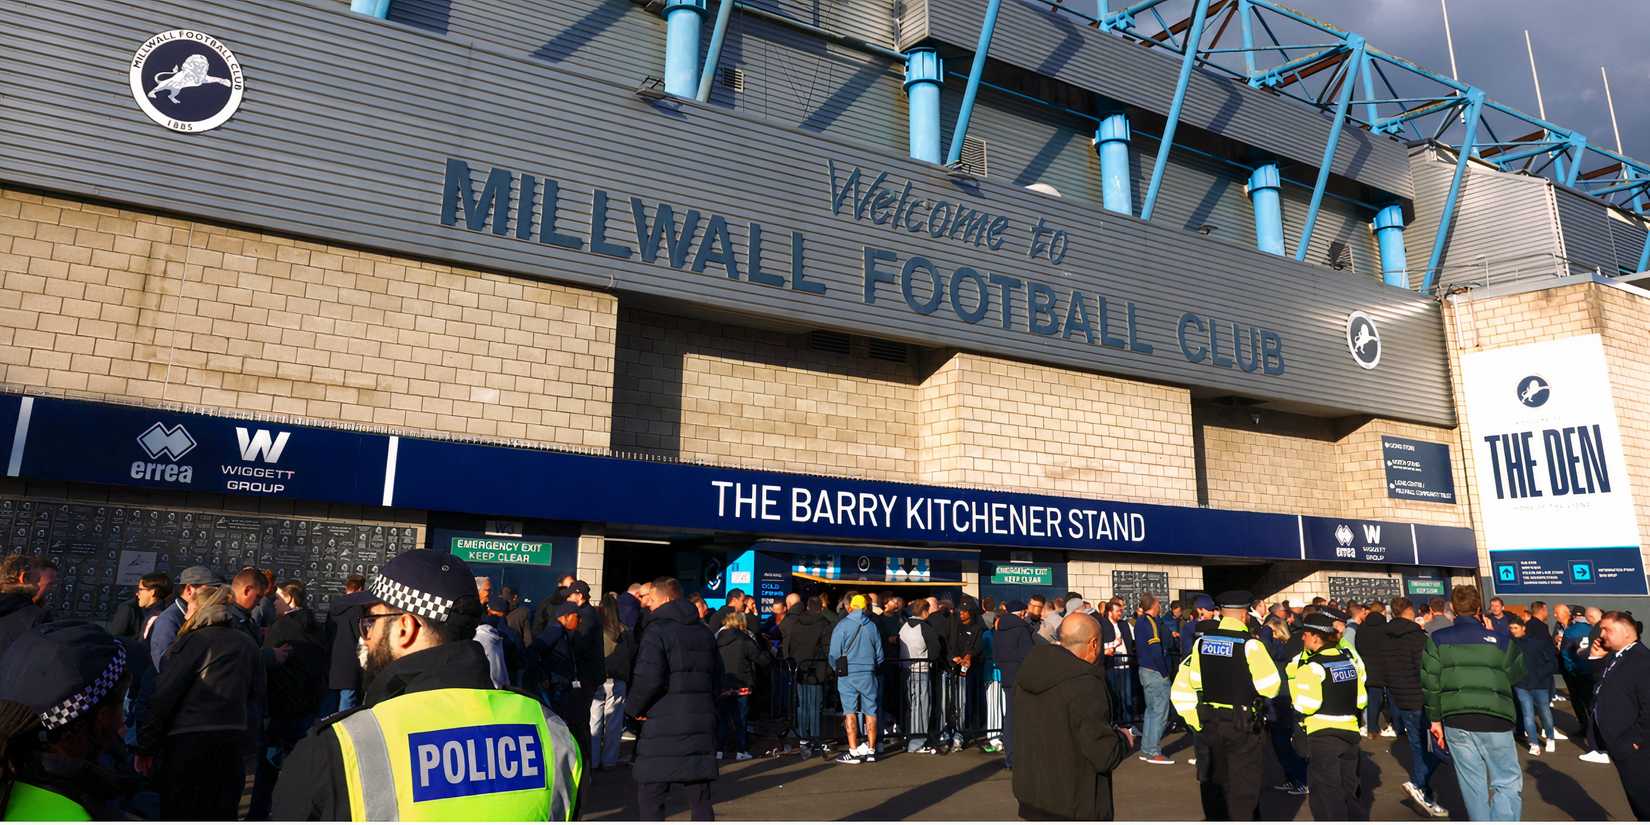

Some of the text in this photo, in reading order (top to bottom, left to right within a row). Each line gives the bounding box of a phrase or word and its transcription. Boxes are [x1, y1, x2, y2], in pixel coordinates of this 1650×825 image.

[133, 31, 242, 90] MILLWALL FOOTBALL CLUB
[167, 120, 193, 131] 1885
[827, 159, 1067, 265] Welcome to
[440, 158, 1284, 376] MILLWALL FOOTBALL CLUB
[221, 464, 295, 480] WIGGETT
[1484, 424, 1611, 499] THE DEN
[227, 480, 285, 493] GROUP
[712, 481, 1145, 542] THE BARRY KITCHENER STAND
[457, 539, 542, 552] EMERGENCY EXIT
[469, 551, 530, 563] KEEP CLEAR
[1202, 645, 1232, 656] POLICE
[418, 735, 538, 787] POLICE
